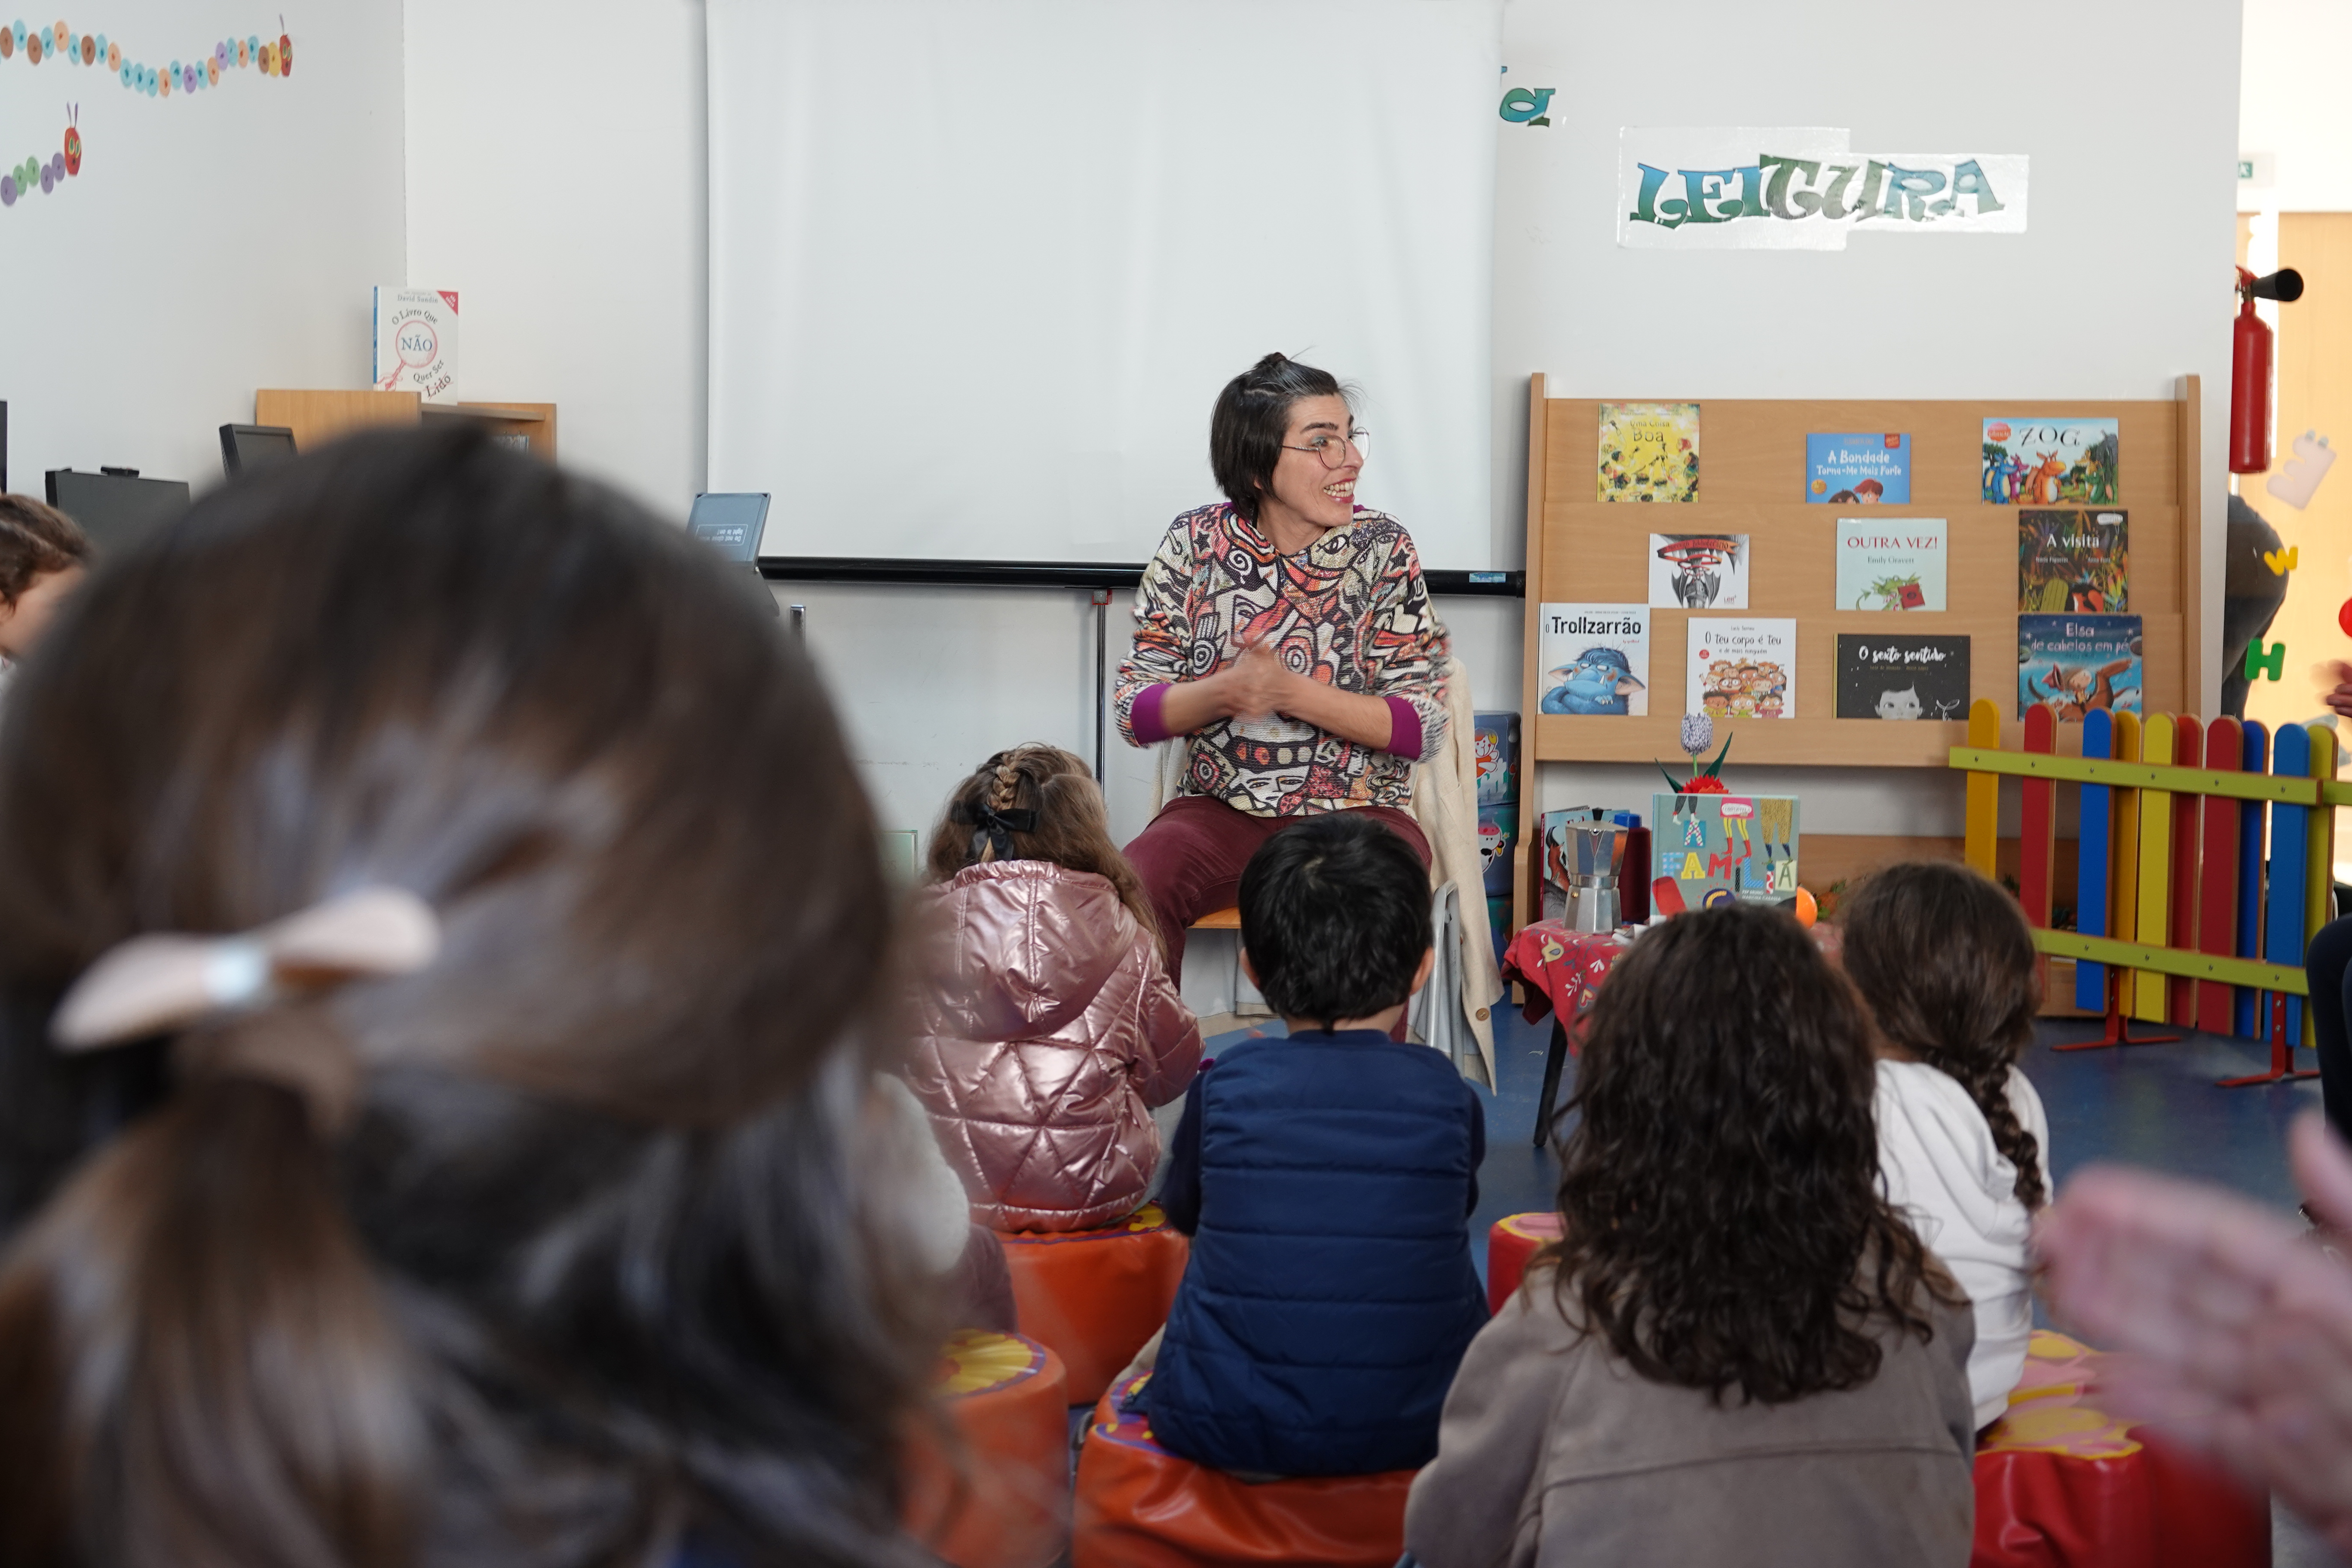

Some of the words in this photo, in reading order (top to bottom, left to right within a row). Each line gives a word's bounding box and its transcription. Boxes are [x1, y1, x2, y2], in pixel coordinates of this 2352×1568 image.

[392, 315, 399, 325] O
[399, 308, 421, 320] Livro
[424, 310, 438, 325] Que
[401, 334, 432, 352] NÃO
[413, 371, 432, 384] Quer
[432, 359, 444, 374] Ser
[426, 375, 450, 398] Lido
[1633, 431, 1663, 442] Boa
[2020, 425, 2080, 448] ZOG
[1828, 450, 1836, 465] A
[1840, 449, 1890, 464] Bondade
[1847, 536, 1901, 549] OUTRA
[1906, 536, 1938, 550] VEZ!
[2046, 533, 2057, 548] A
[2062, 533, 2099, 548] visita
[1868, 556, 1886, 565] Emily
[1552, 616, 1641, 635] Trollzarrão
[2066, 622, 2094, 638] Elsa
[1706, 631, 1711, 644] O
[1715, 633, 1729, 645] teu
[1732, 636, 1755, 648] corpo
[1758, 634, 1763, 645] é
[1767, 634, 1781, 645] teu
[2031, 638, 2045, 652] de
[2047, 638, 2092, 652] cabelos
[2095, 642, 2113, 652] em
[2116, 637, 2129, 656] pé
[1859, 646, 1869, 661] O
[1872, 646, 1902, 664] sexto
[1904, 646, 1946, 664] sentido
[2245, 637, 2286, 682] H
[1684, 821, 1703, 847] A
